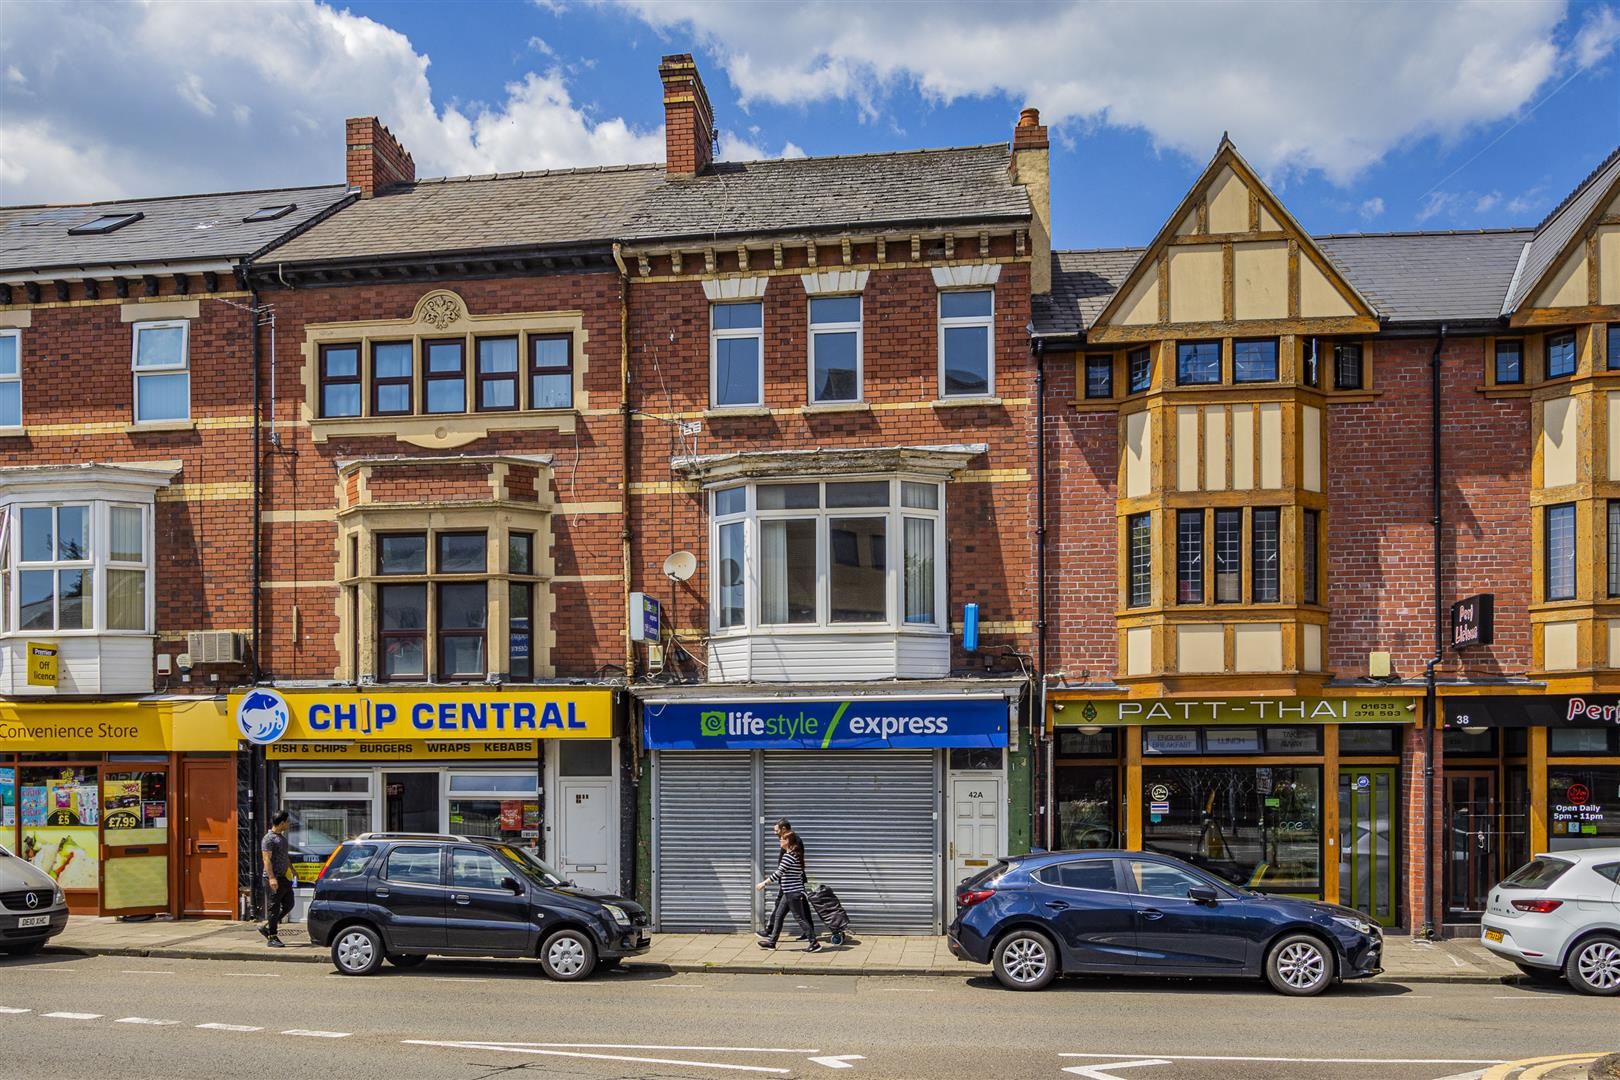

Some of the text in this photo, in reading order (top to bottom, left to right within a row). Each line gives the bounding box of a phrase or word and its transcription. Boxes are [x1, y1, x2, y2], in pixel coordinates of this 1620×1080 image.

[39, 661, 50, 670] Off
[33, 671, 56, 680] licence
[1118, 701, 1347, 720] PATT-THAI
[308, 698, 587, 734] CHIP CENTRAL
[1456, 715, 1470, 725] 38
[0, 722, 138, 739] Convenience Store
[728, 711, 949, 741] lifestyle express
[272, 742, 532, 753] FISH & CHIPS BURGERS WRAPS KEBABS
[968, 791, 984, 799] 42A
[1555, 804, 1601, 813] Open Daily
[58, 815, 70, 825] £5
[108, 816, 137, 828] £7.99
[1553, 813, 1572, 821] 5pm
[1579, 813, 1604, 821] 11pm
